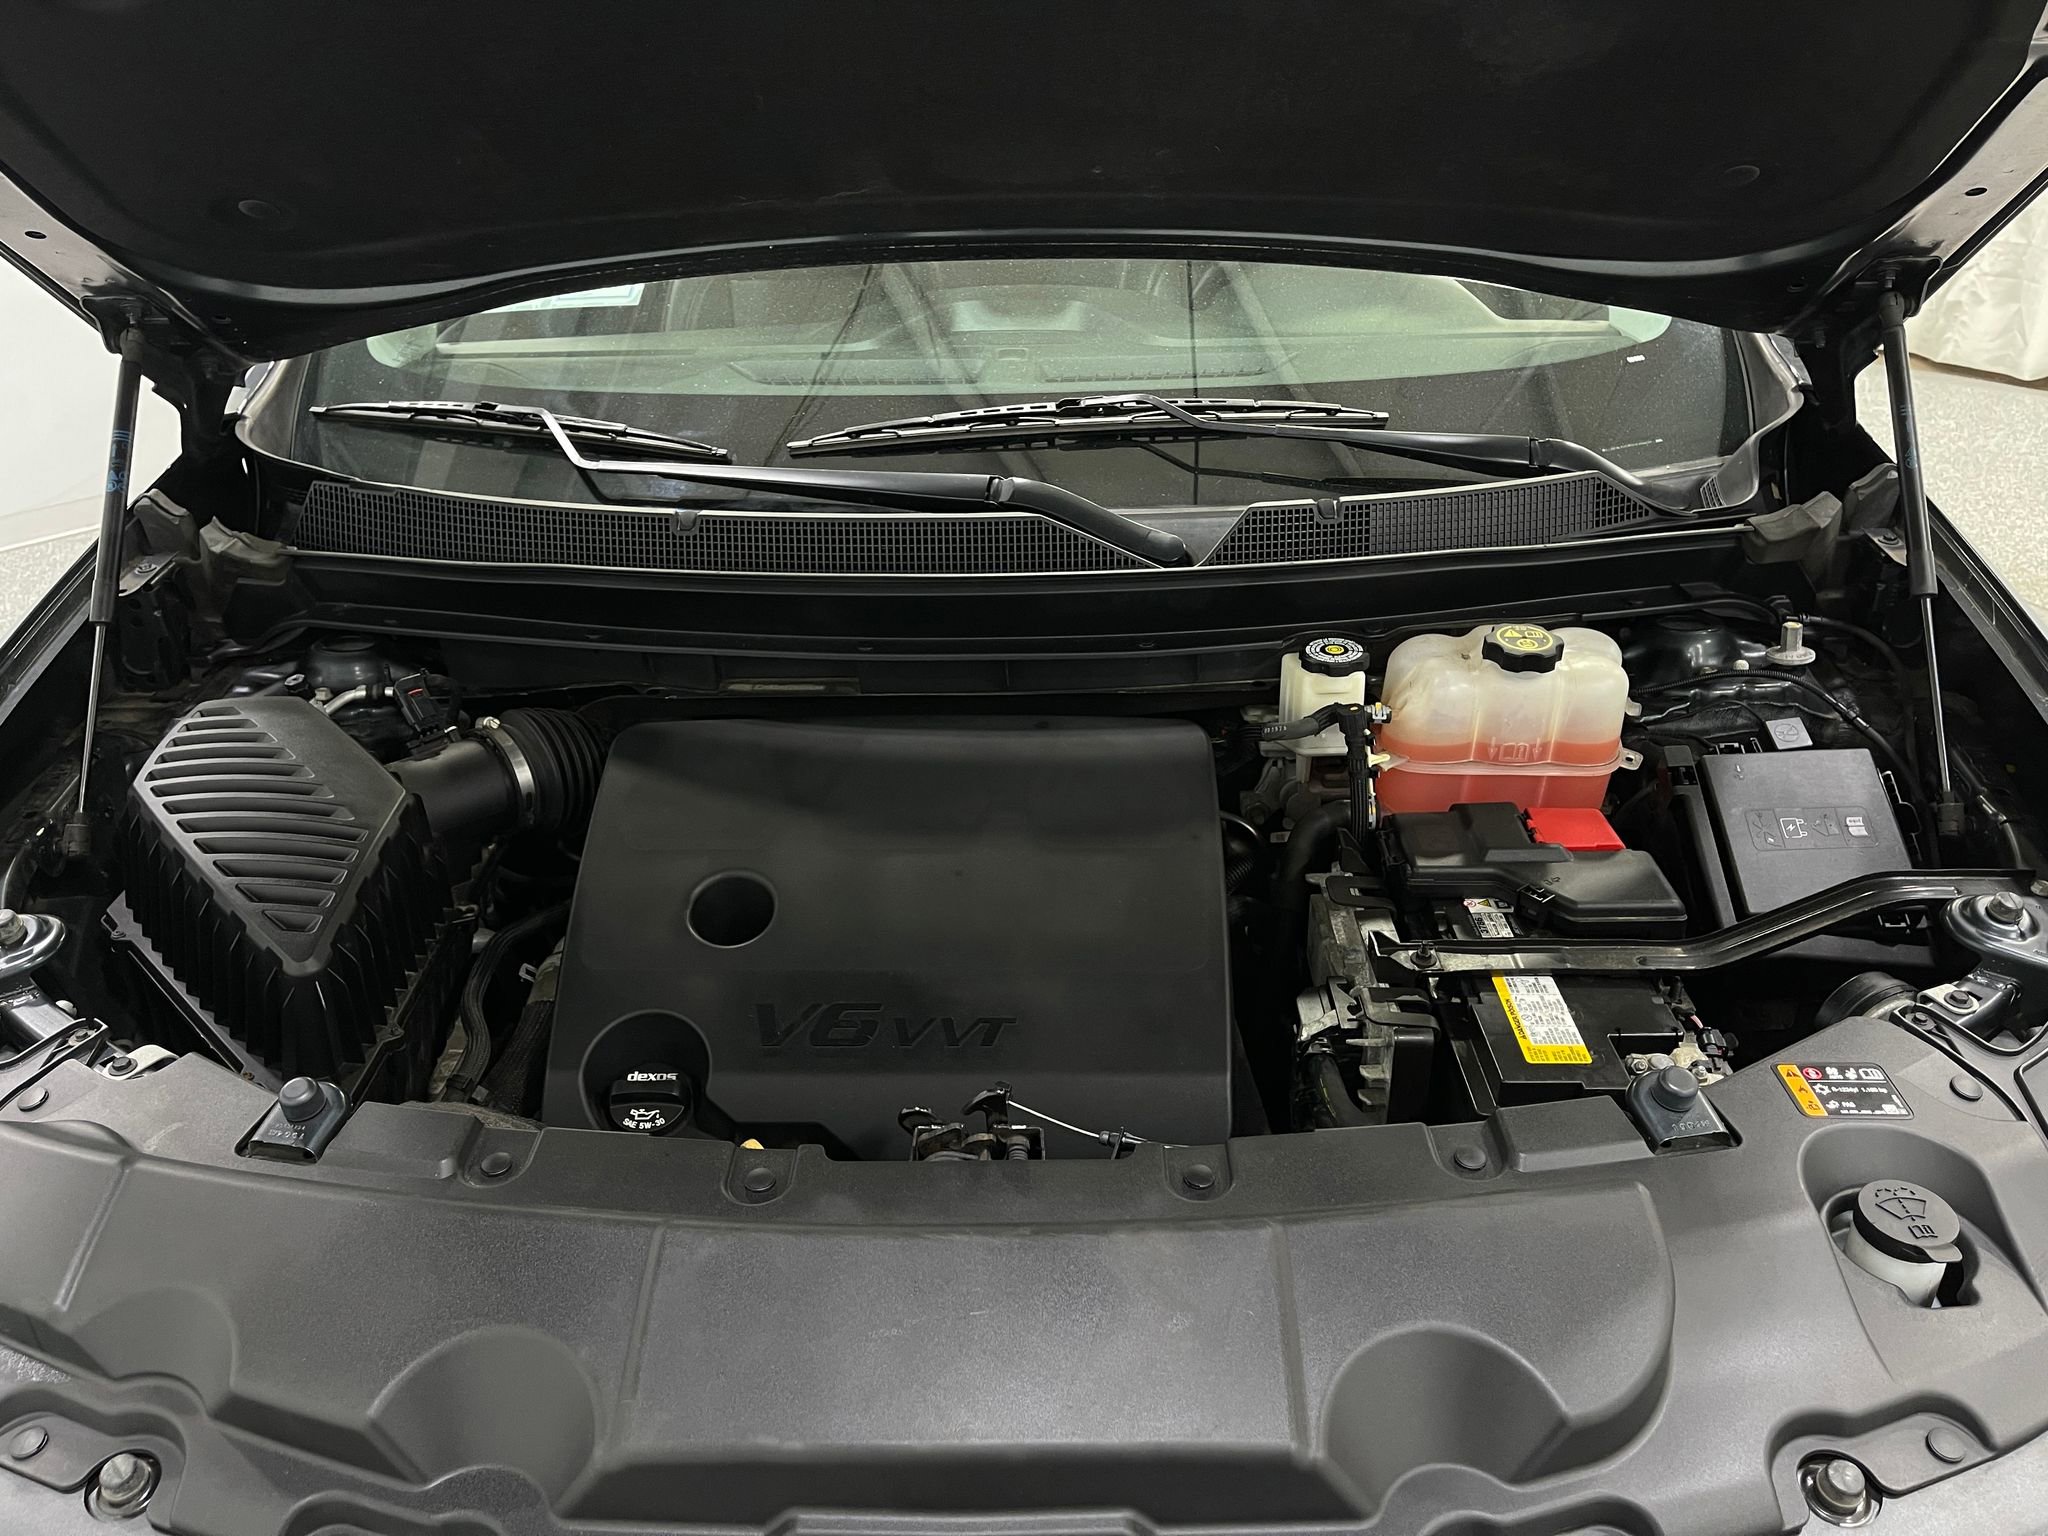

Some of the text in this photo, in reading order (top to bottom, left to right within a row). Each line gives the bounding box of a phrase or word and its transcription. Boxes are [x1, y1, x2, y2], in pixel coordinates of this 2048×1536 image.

[755, 1001, 1018, 1047] V6 VVT
[627, 1071, 679, 1081] dexos
[623, 1118, 666, 1129] SAE 5W-30
